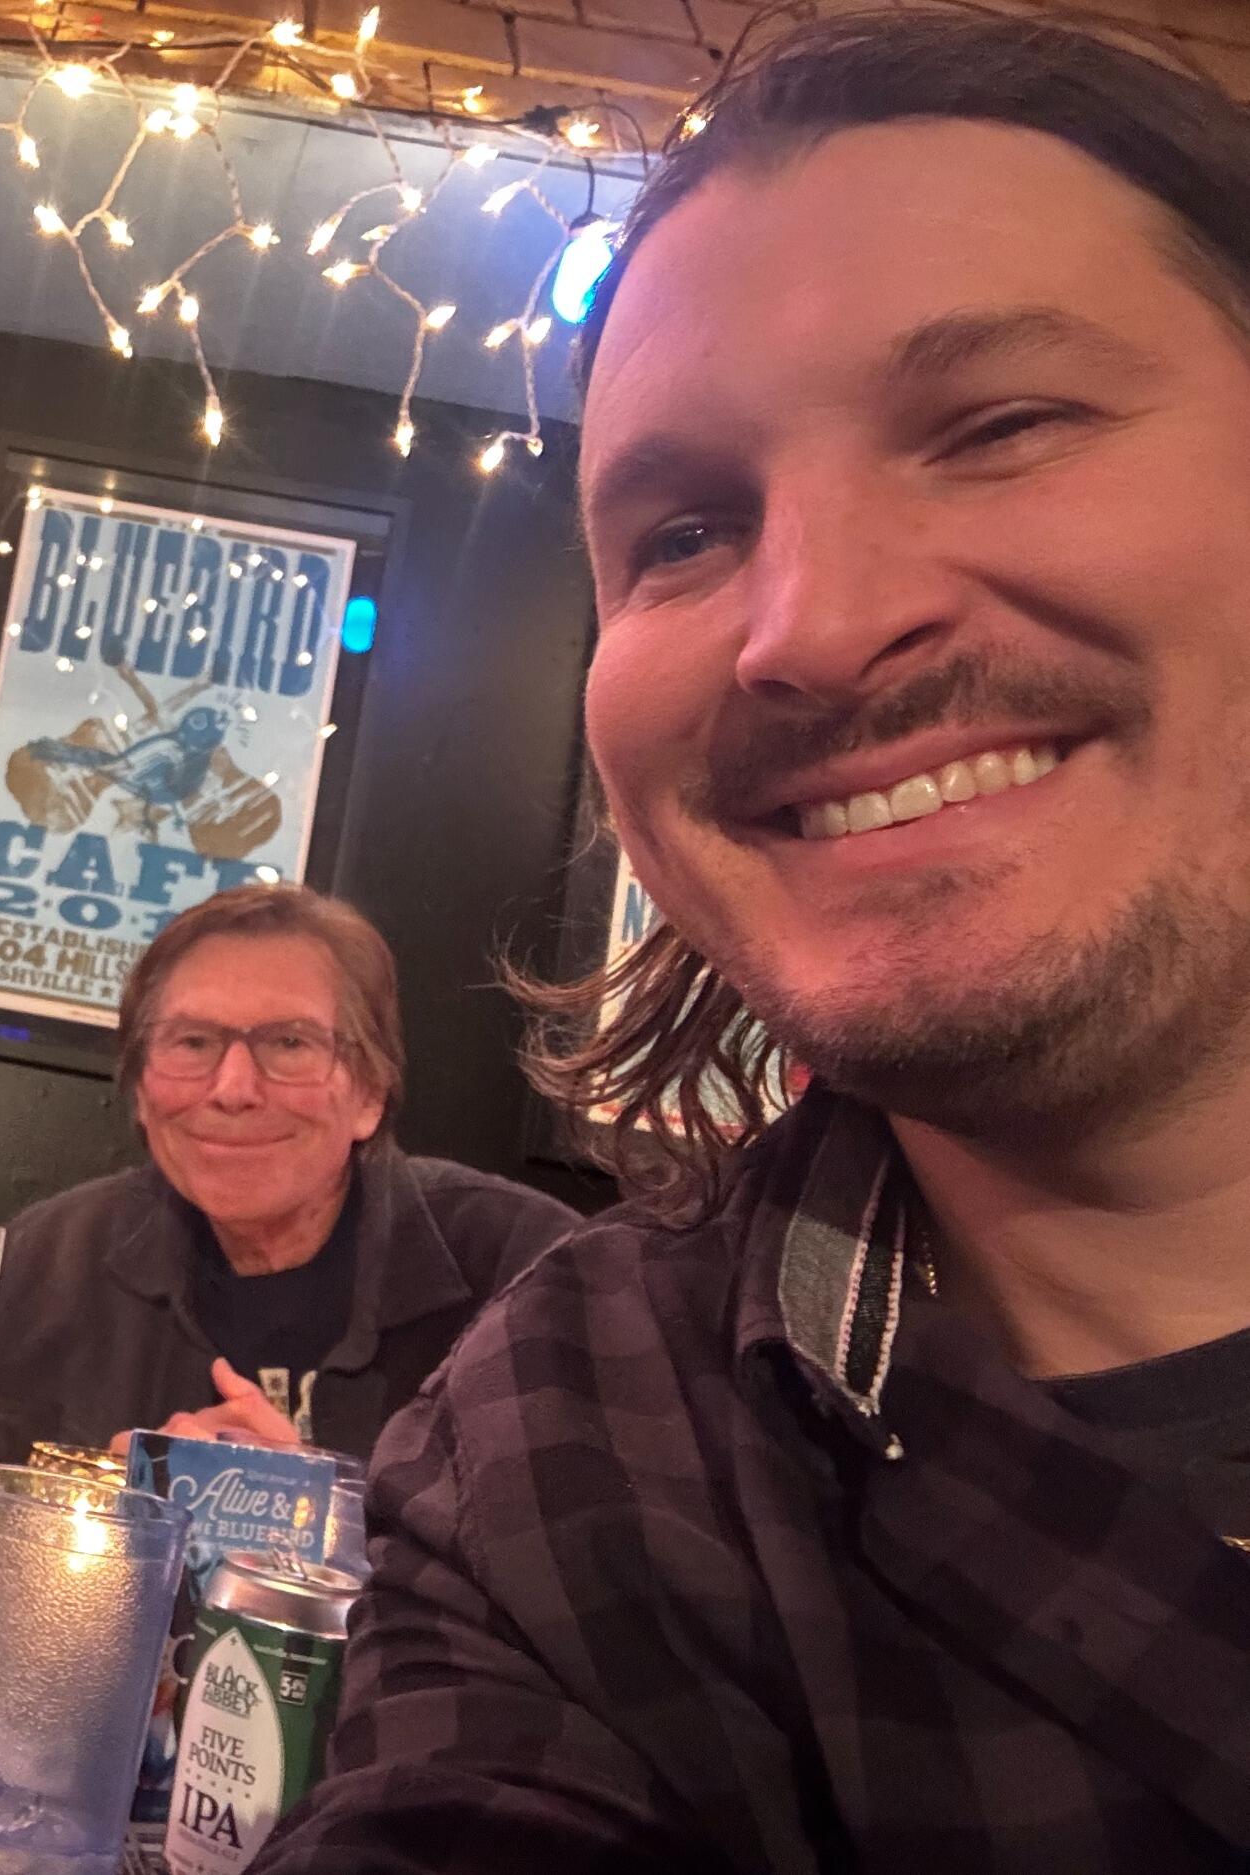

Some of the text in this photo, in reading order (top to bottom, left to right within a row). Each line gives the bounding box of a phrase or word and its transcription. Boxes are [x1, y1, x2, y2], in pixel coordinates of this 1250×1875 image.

[20, 508, 331, 697] BLUEBIRD
[169, 1467, 292, 1521] Alive &
[188, 1742, 257, 1785] POINTS
[201, 1725, 245, 1759] FIVE
[179, 1782, 243, 1849] IPA
